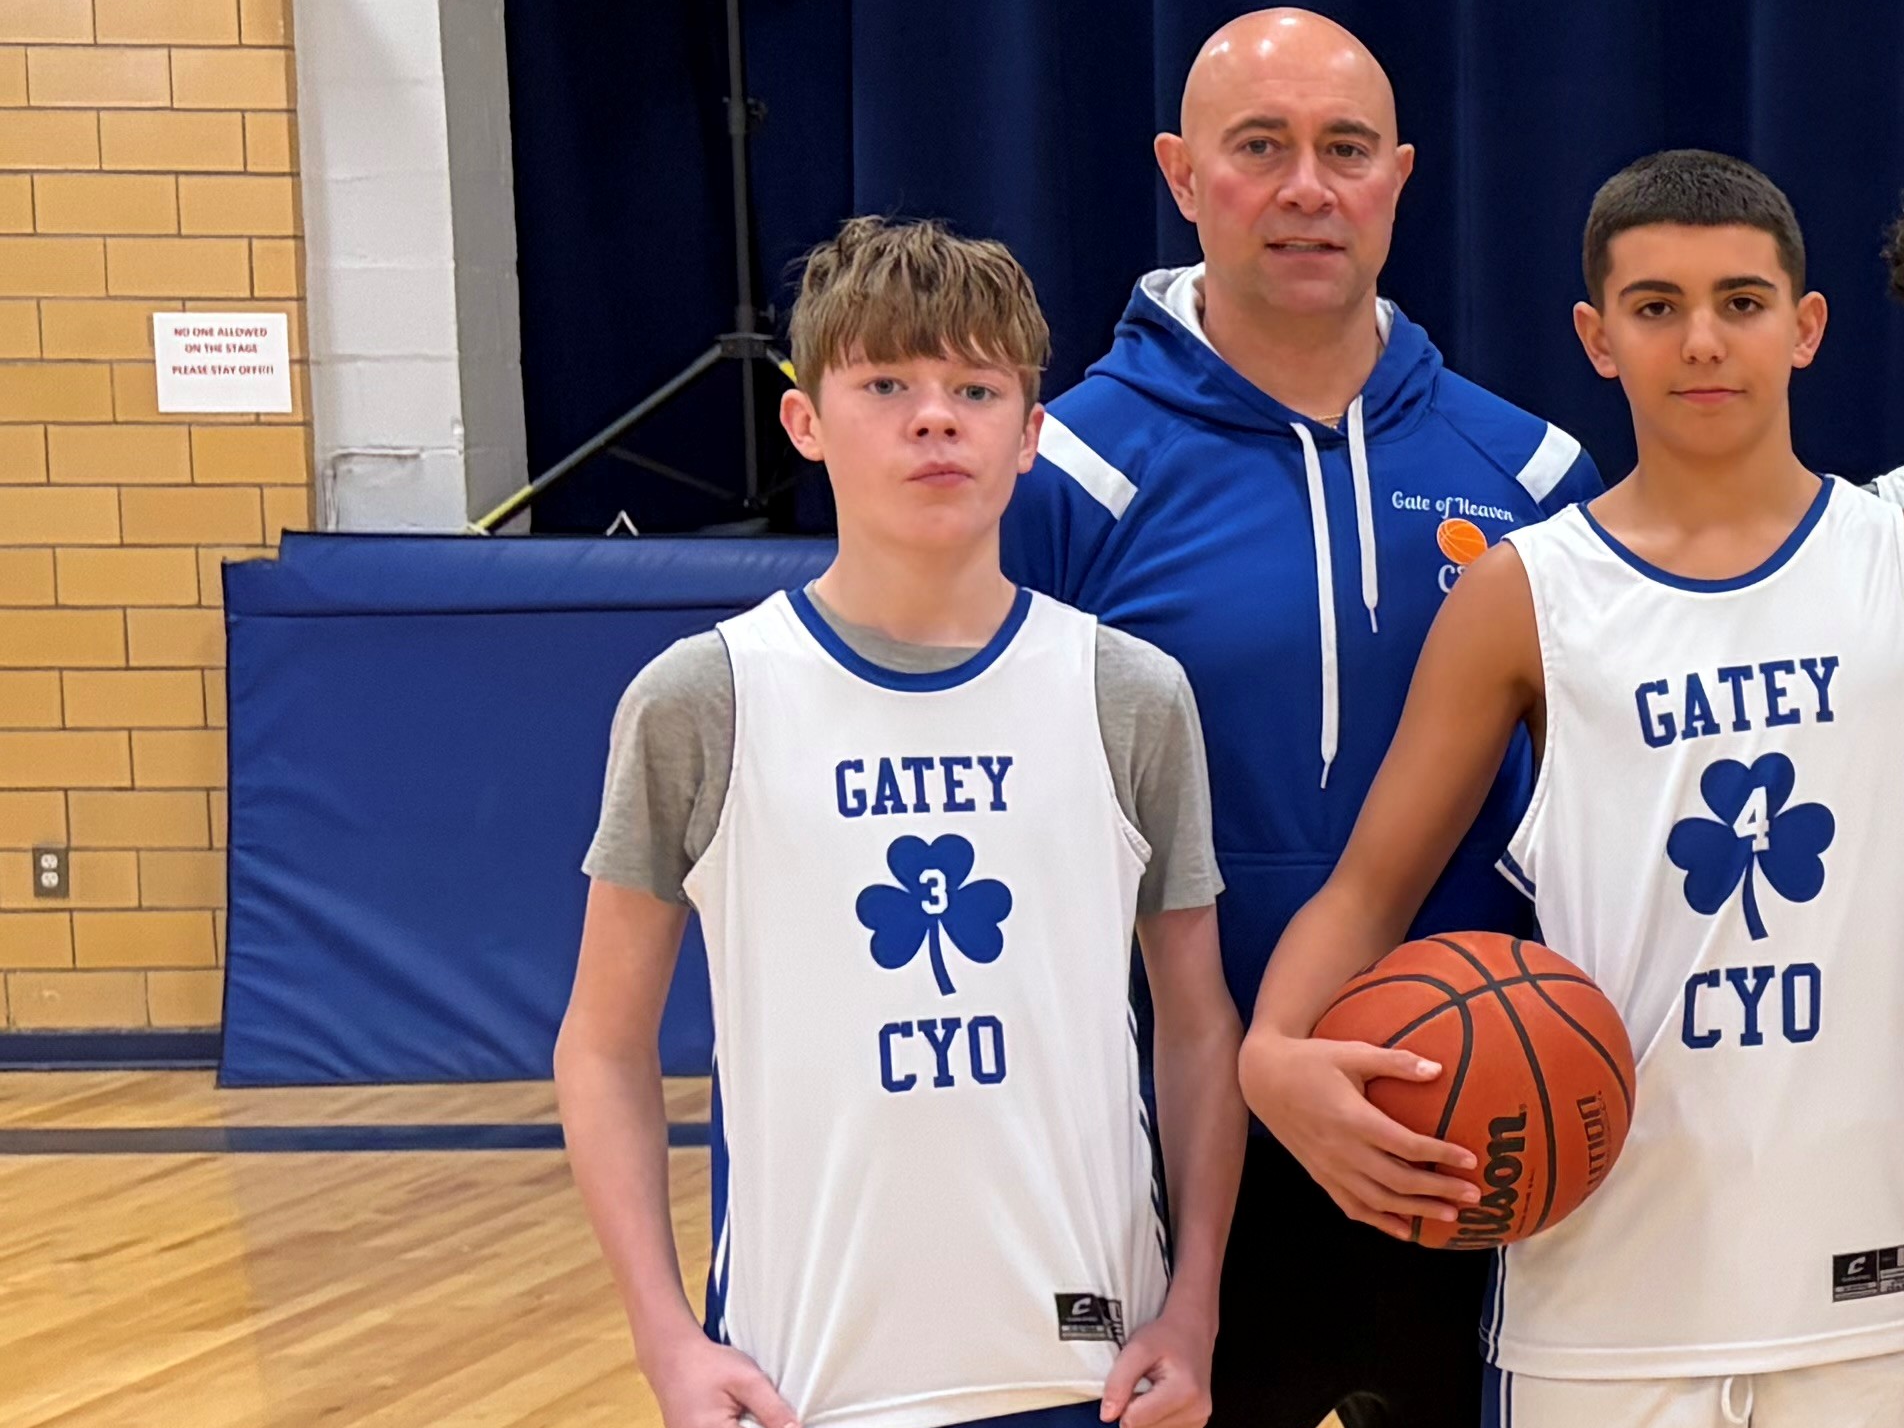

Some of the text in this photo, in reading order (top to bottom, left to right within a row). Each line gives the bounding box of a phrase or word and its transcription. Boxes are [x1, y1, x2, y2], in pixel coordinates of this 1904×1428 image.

[174, 327, 268, 337] NO ONE ALLOWED
[184, 343, 258, 353] ON THE STAGE
[172, 365, 208, 375] PLEASE
[211, 365, 236, 375] STAY
[1391, 491, 1514, 522] Gate of Heaven
[1635, 655, 1839, 748] GATEY
[835, 755, 1013, 818] GATEY
[1733, 785, 1771, 852] 4
[920, 869, 949, 914] 3
[1681, 962, 1821, 1049] CYO
[878, 1015, 1007, 1093] CYO
